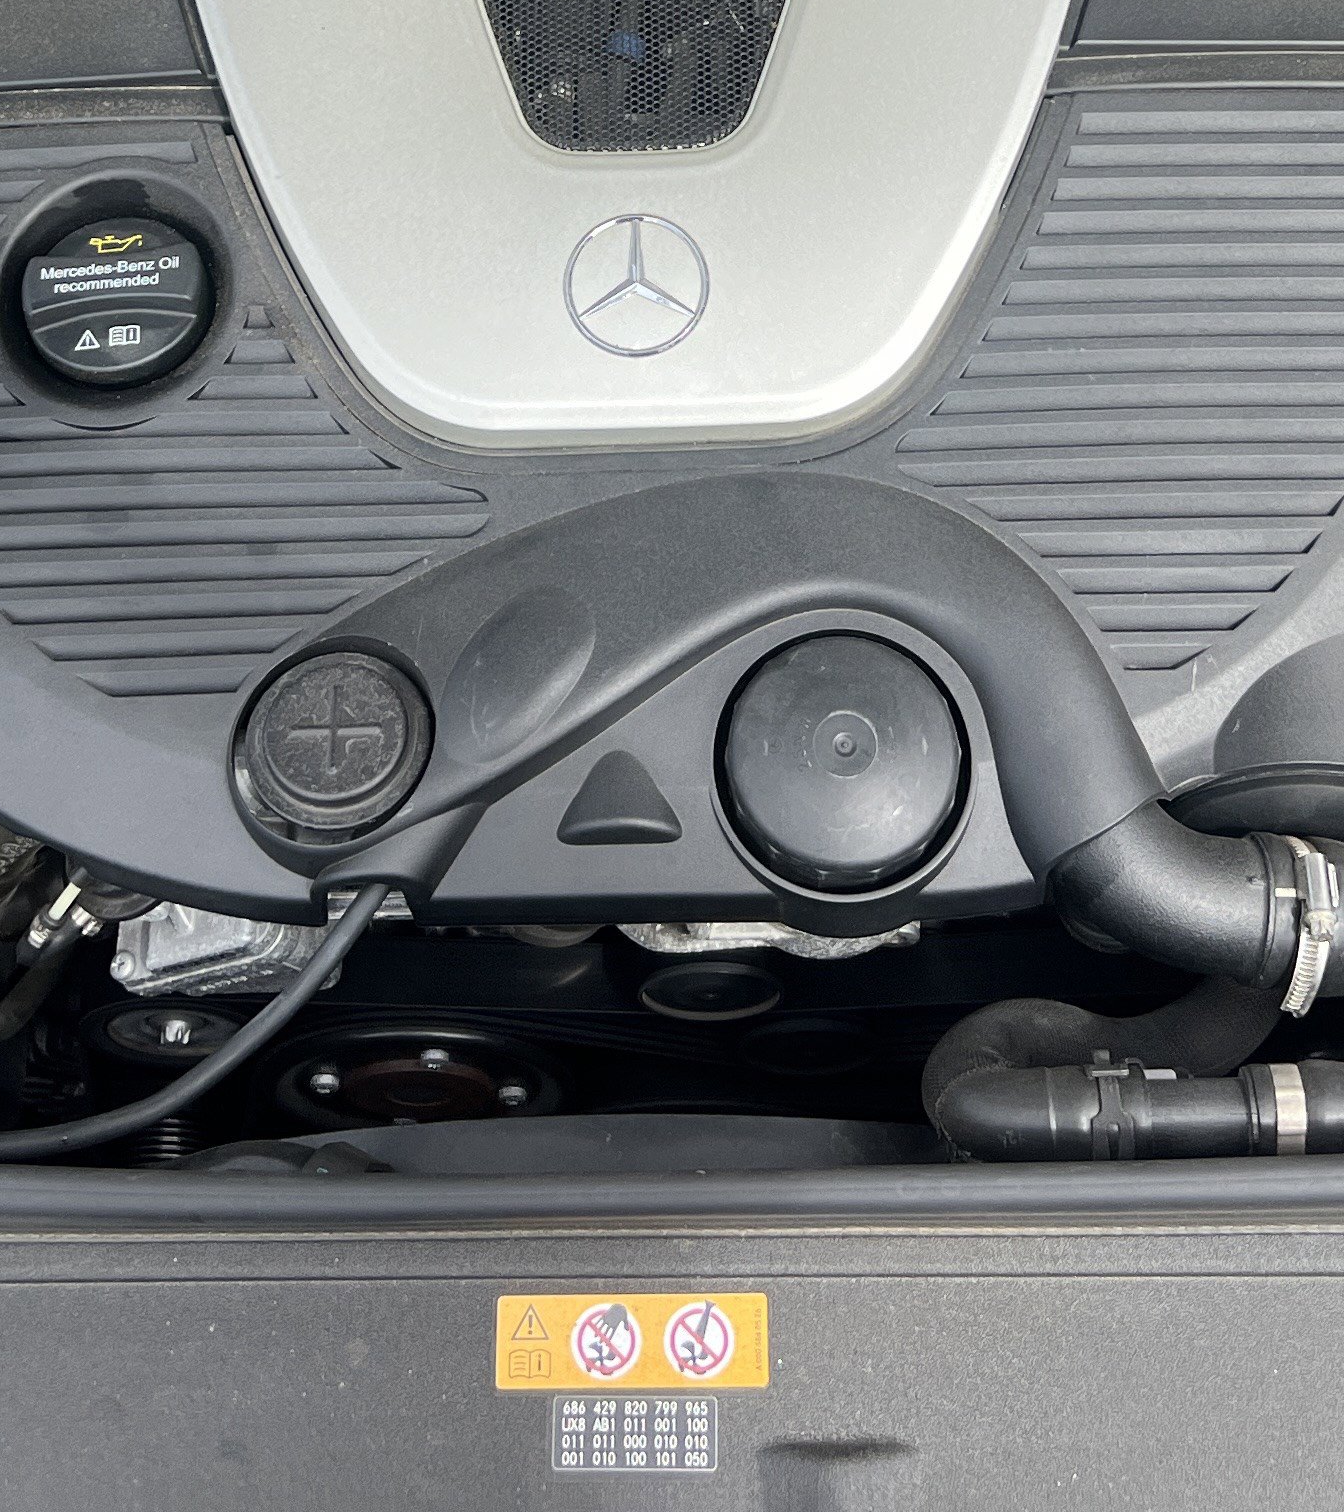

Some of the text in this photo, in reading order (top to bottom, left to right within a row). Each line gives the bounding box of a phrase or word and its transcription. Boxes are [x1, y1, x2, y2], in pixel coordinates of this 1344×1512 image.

[41, 256, 180, 281] Mercedes-Benz Oil
[53, 272, 159, 294] recommended
[563, 1400, 708, 1416] 686 429 820 799 965
[623, 1417, 646, 1432] 011
[654, 1417, 677, 1432] 001
[686, 1417, 709, 1432] 100
[561, 1434, 709, 1449] 011 011 000 010 010
[561, 1451, 584, 1466] 001
[592, 1451, 616, 1466] 010
[625, 1451, 647, 1466] 100
[655, 1451, 676, 1466] 101
